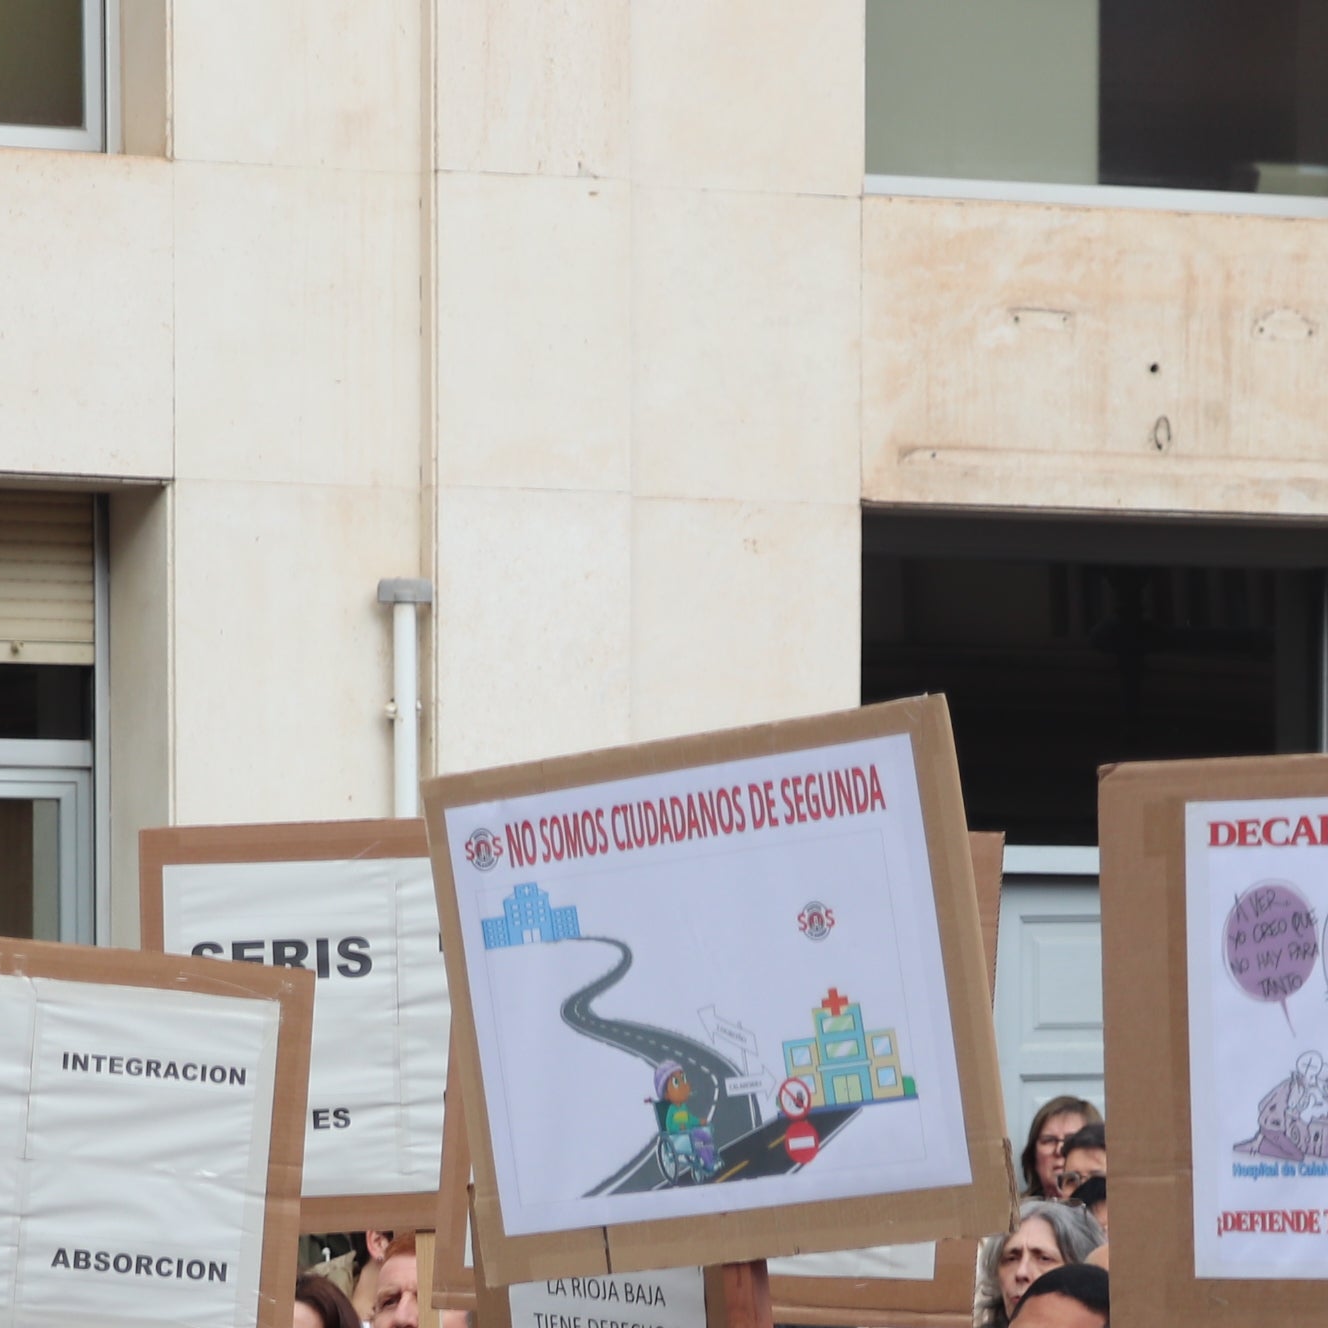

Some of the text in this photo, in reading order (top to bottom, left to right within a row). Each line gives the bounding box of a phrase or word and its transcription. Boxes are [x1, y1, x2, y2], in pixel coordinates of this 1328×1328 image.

[505, 764, 887, 868] NO SOMOS CIUDADANOS DE SEGUNDA
[1252, 921, 1287, 944] CREO
[1291, 908, 1318, 937] QUE
[1257, 950, 1281, 969] HAY
[1258, 974, 1303, 997] TANTO
[62, 1051, 247, 1086] INTEGRACION
[1217, 1209, 1320, 1237] ¡DEFIENDE
[50, 1247, 227, 1282] ABSORCION
[547, 1277, 666, 1307] LA RIOJA BAJA
